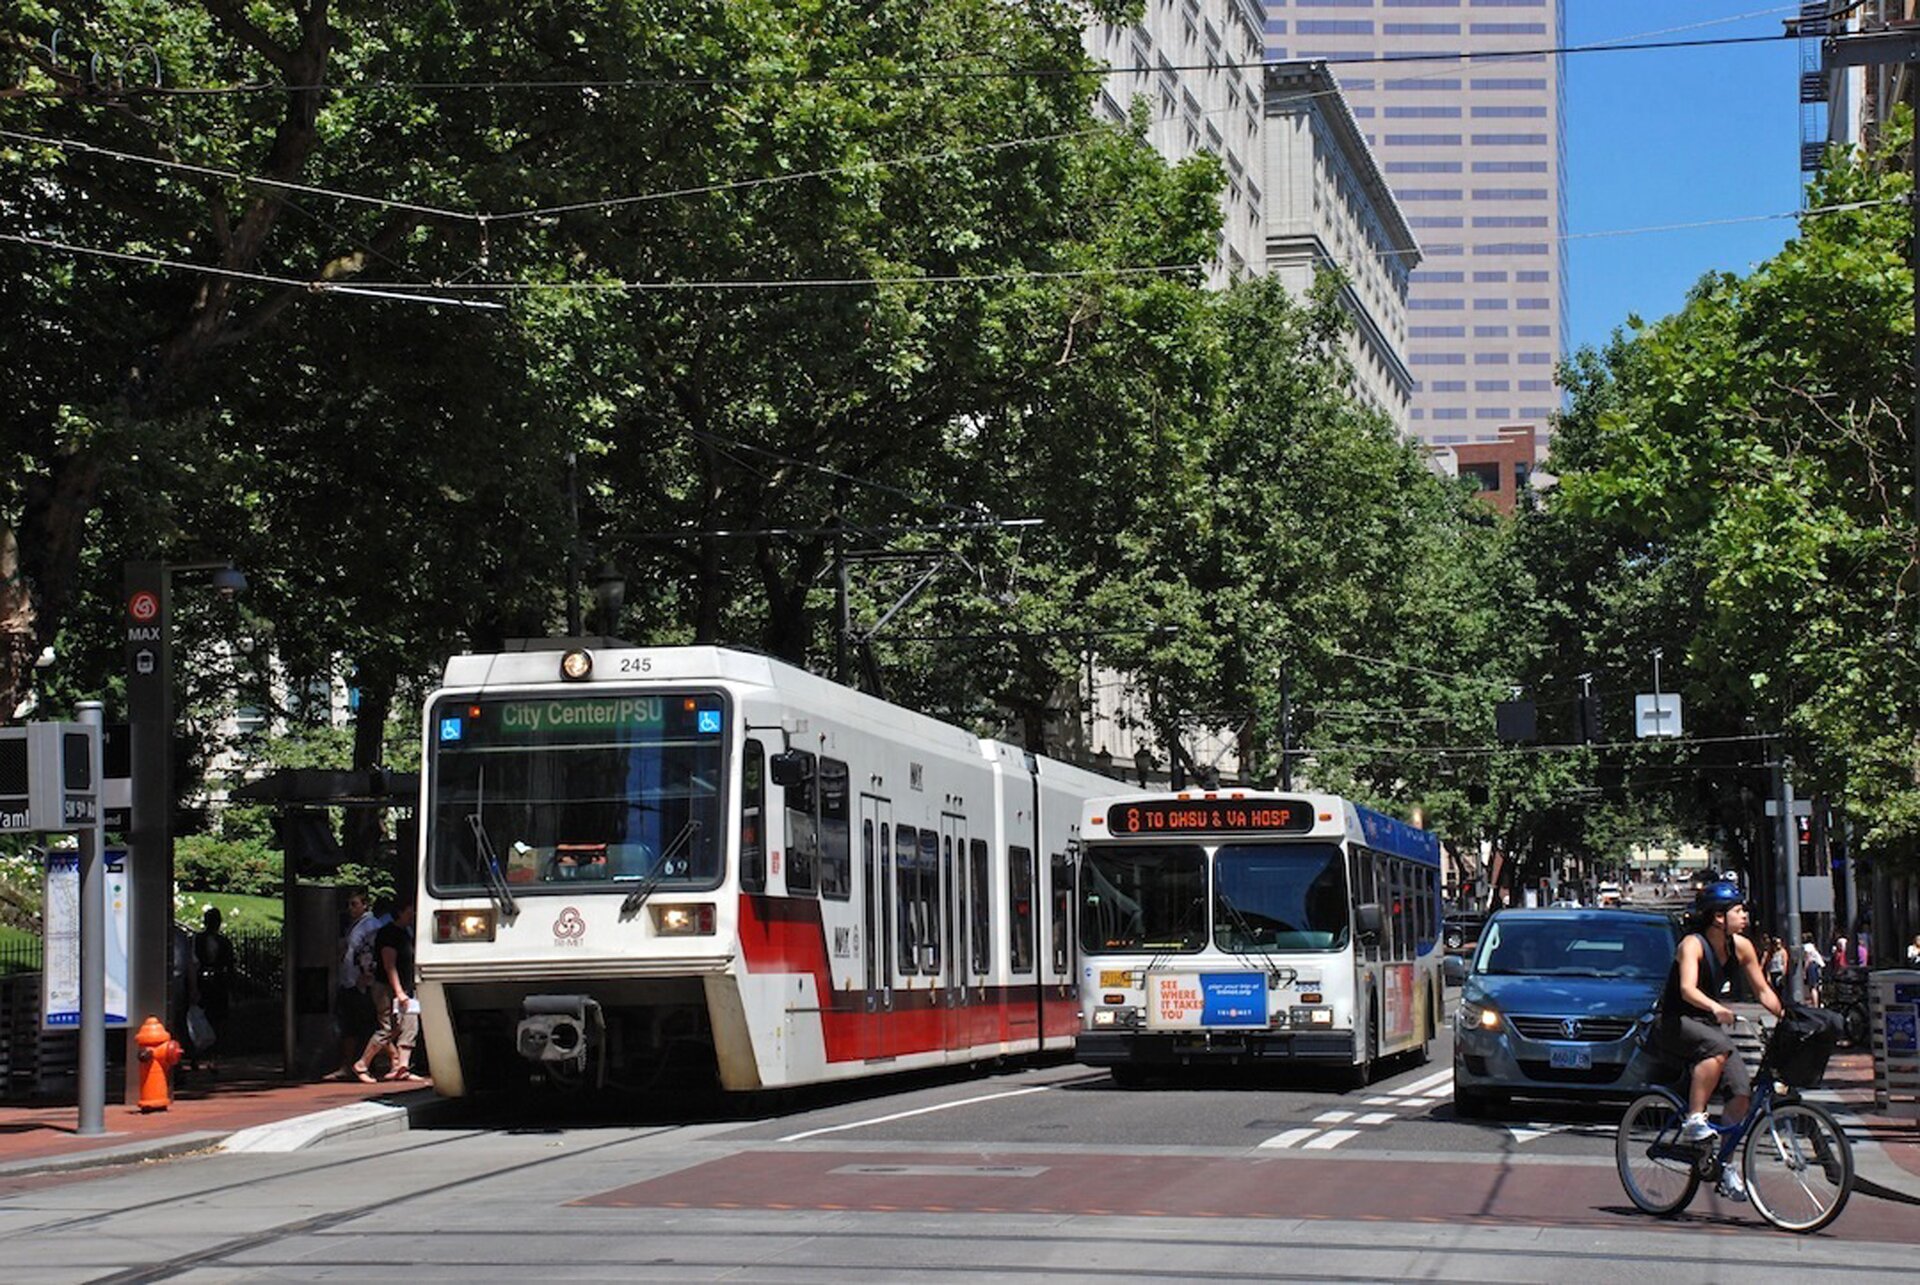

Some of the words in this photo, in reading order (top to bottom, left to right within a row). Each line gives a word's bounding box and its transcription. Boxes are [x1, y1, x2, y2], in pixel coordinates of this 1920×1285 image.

[128, 627, 160, 641] MAX
[620, 658, 652, 672] 245
[502, 703, 541, 731] City
[547, 698, 663, 725] Center/PSU
[1127, 808, 1140, 832] 8
[1146, 811, 1164, 828] TO
[1169, 811, 1207, 828] OHSU
[1212, 811, 1222, 827] &
[1226, 810, 1247, 827] VA
[1251, 809, 1290, 827] HOSP
[1161, 981, 1177, 990] SEE
[1161, 990, 1196, 999] WHERE
[1161, 1000, 1170, 1009] IT
[1174, 1000, 1205, 1009] TAKES
[1161, 1010, 1183, 1019] YOU
